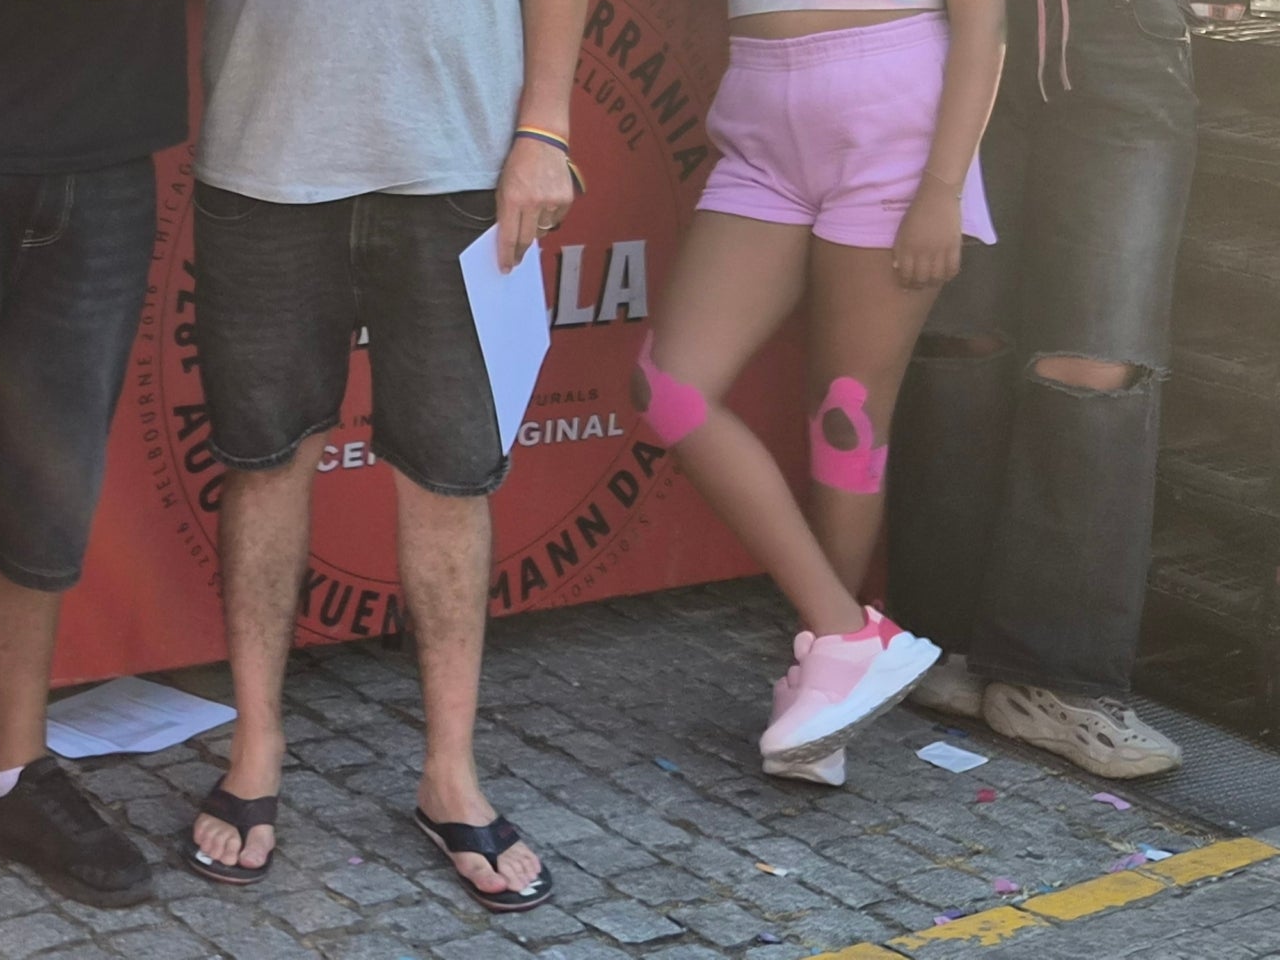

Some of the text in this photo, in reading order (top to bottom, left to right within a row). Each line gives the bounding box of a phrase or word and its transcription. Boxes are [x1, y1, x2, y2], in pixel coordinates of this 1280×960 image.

[137, 355, 178, 509] MELBOURNE
[518, 413, 625, 446] GINAL
[549, 512, 651, 608] STOCKHOL
